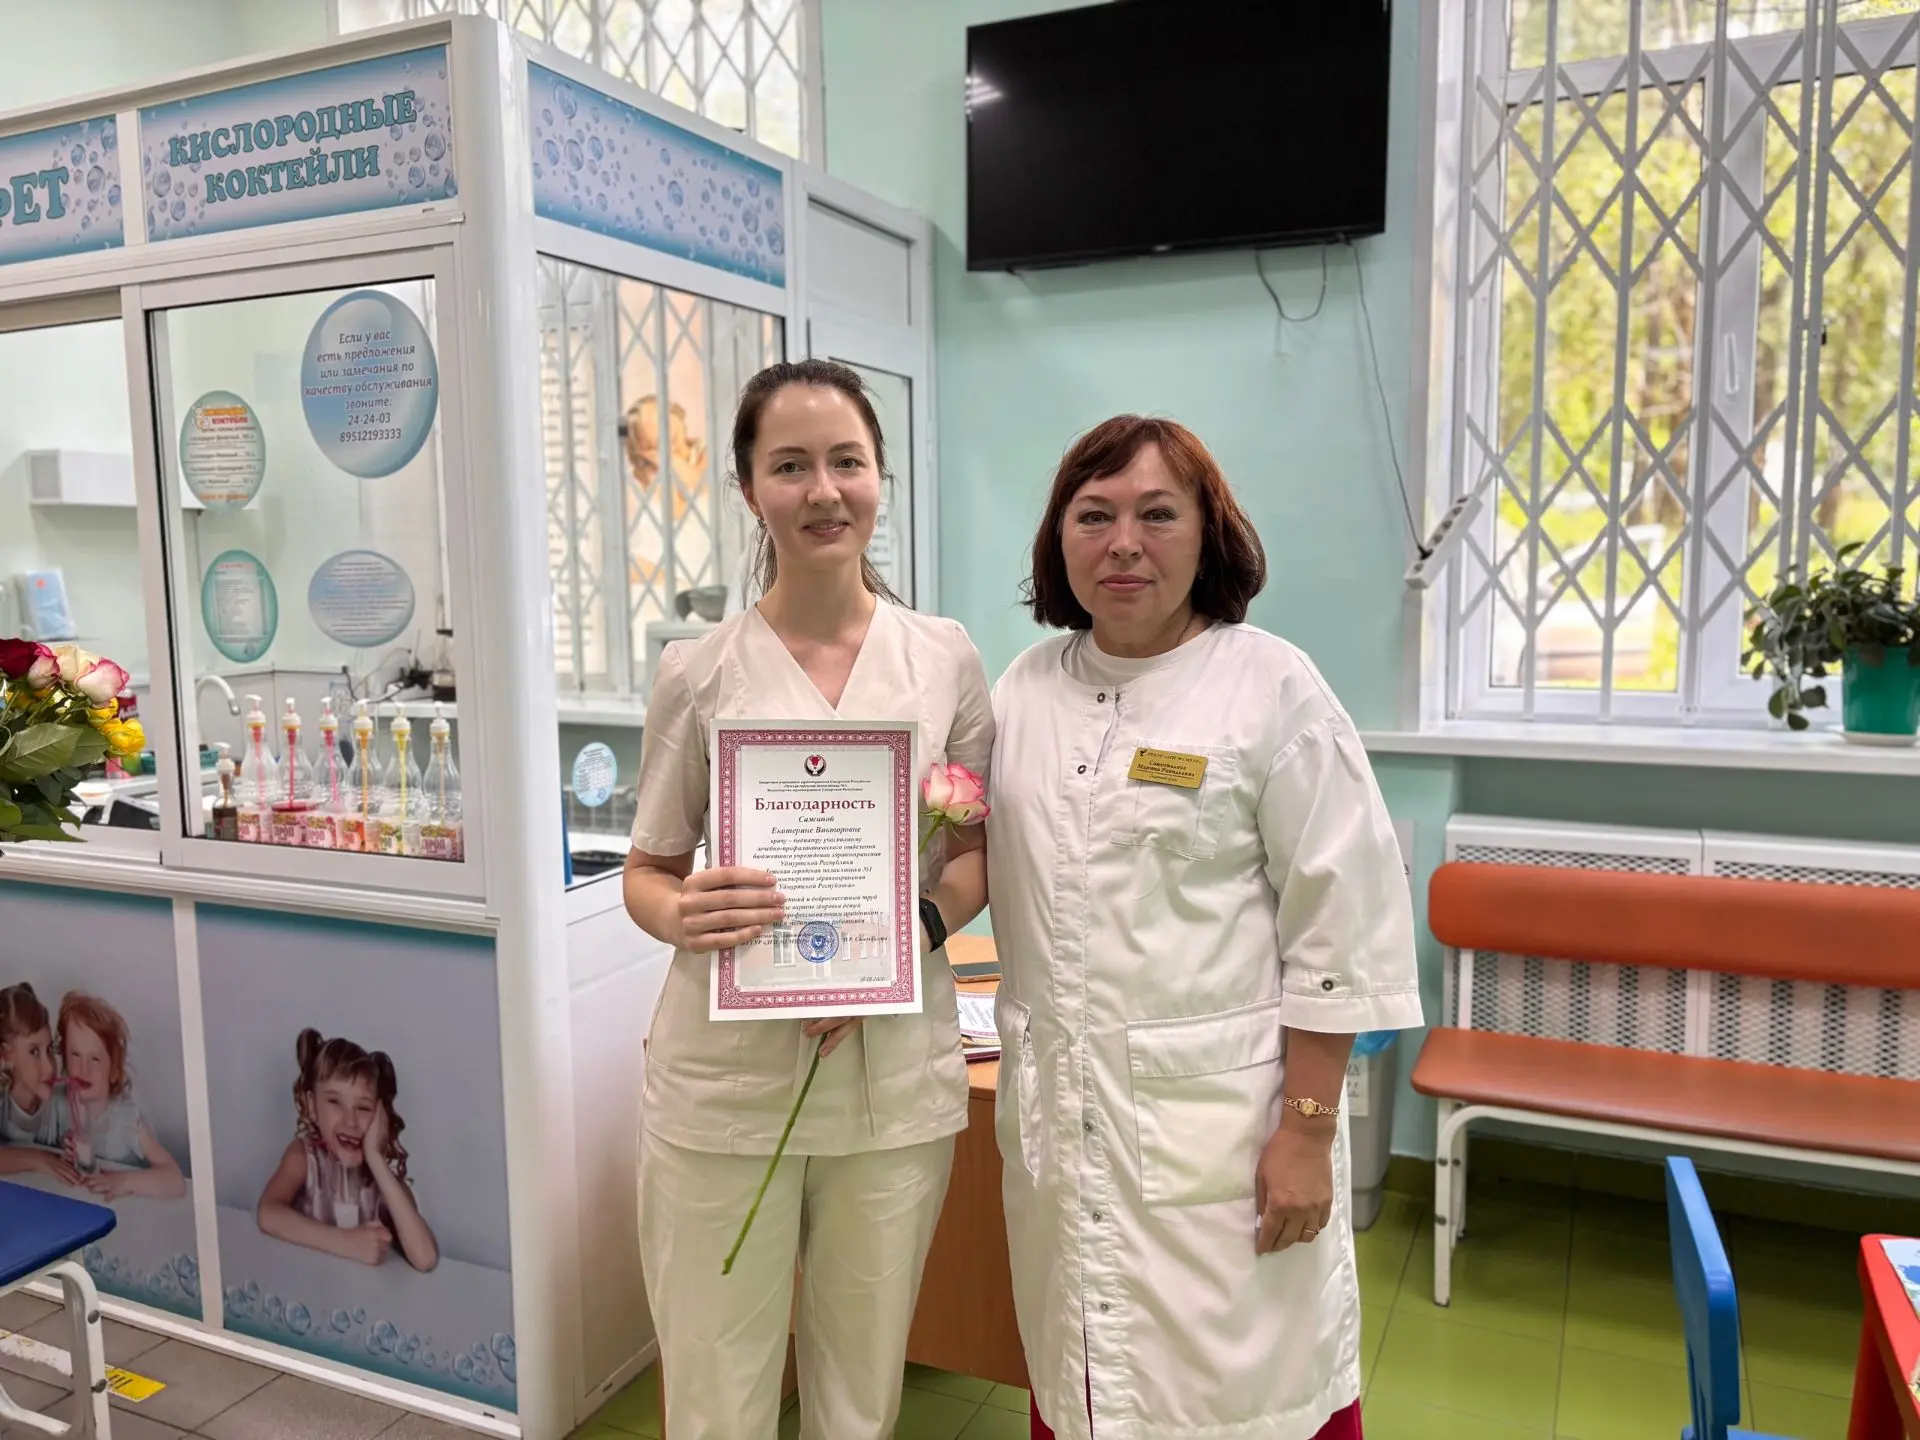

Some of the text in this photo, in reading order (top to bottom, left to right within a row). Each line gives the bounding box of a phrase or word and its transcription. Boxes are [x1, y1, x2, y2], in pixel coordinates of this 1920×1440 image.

[168, 90, 417, 166] КИСЛОРОДНЫЕ
[204, 146, 380, 203] КОКТЕЙЛИ
[339, 330, 391, 344] Если у вас
[317, 345, 415, 363] есть предложения
[320, 362, 415, 379] или замечания по
[305, 377, 432, 396] качеству обслуживания
[345, 398, 392, 409] звоните:
[348, 412, 391, 425] 24-24-03
[340, 428, 402, 442] 89512193333
[755, 798, 876, 813] Благодарность
[771, 826, 862, 835] Екатерине Викторовне
